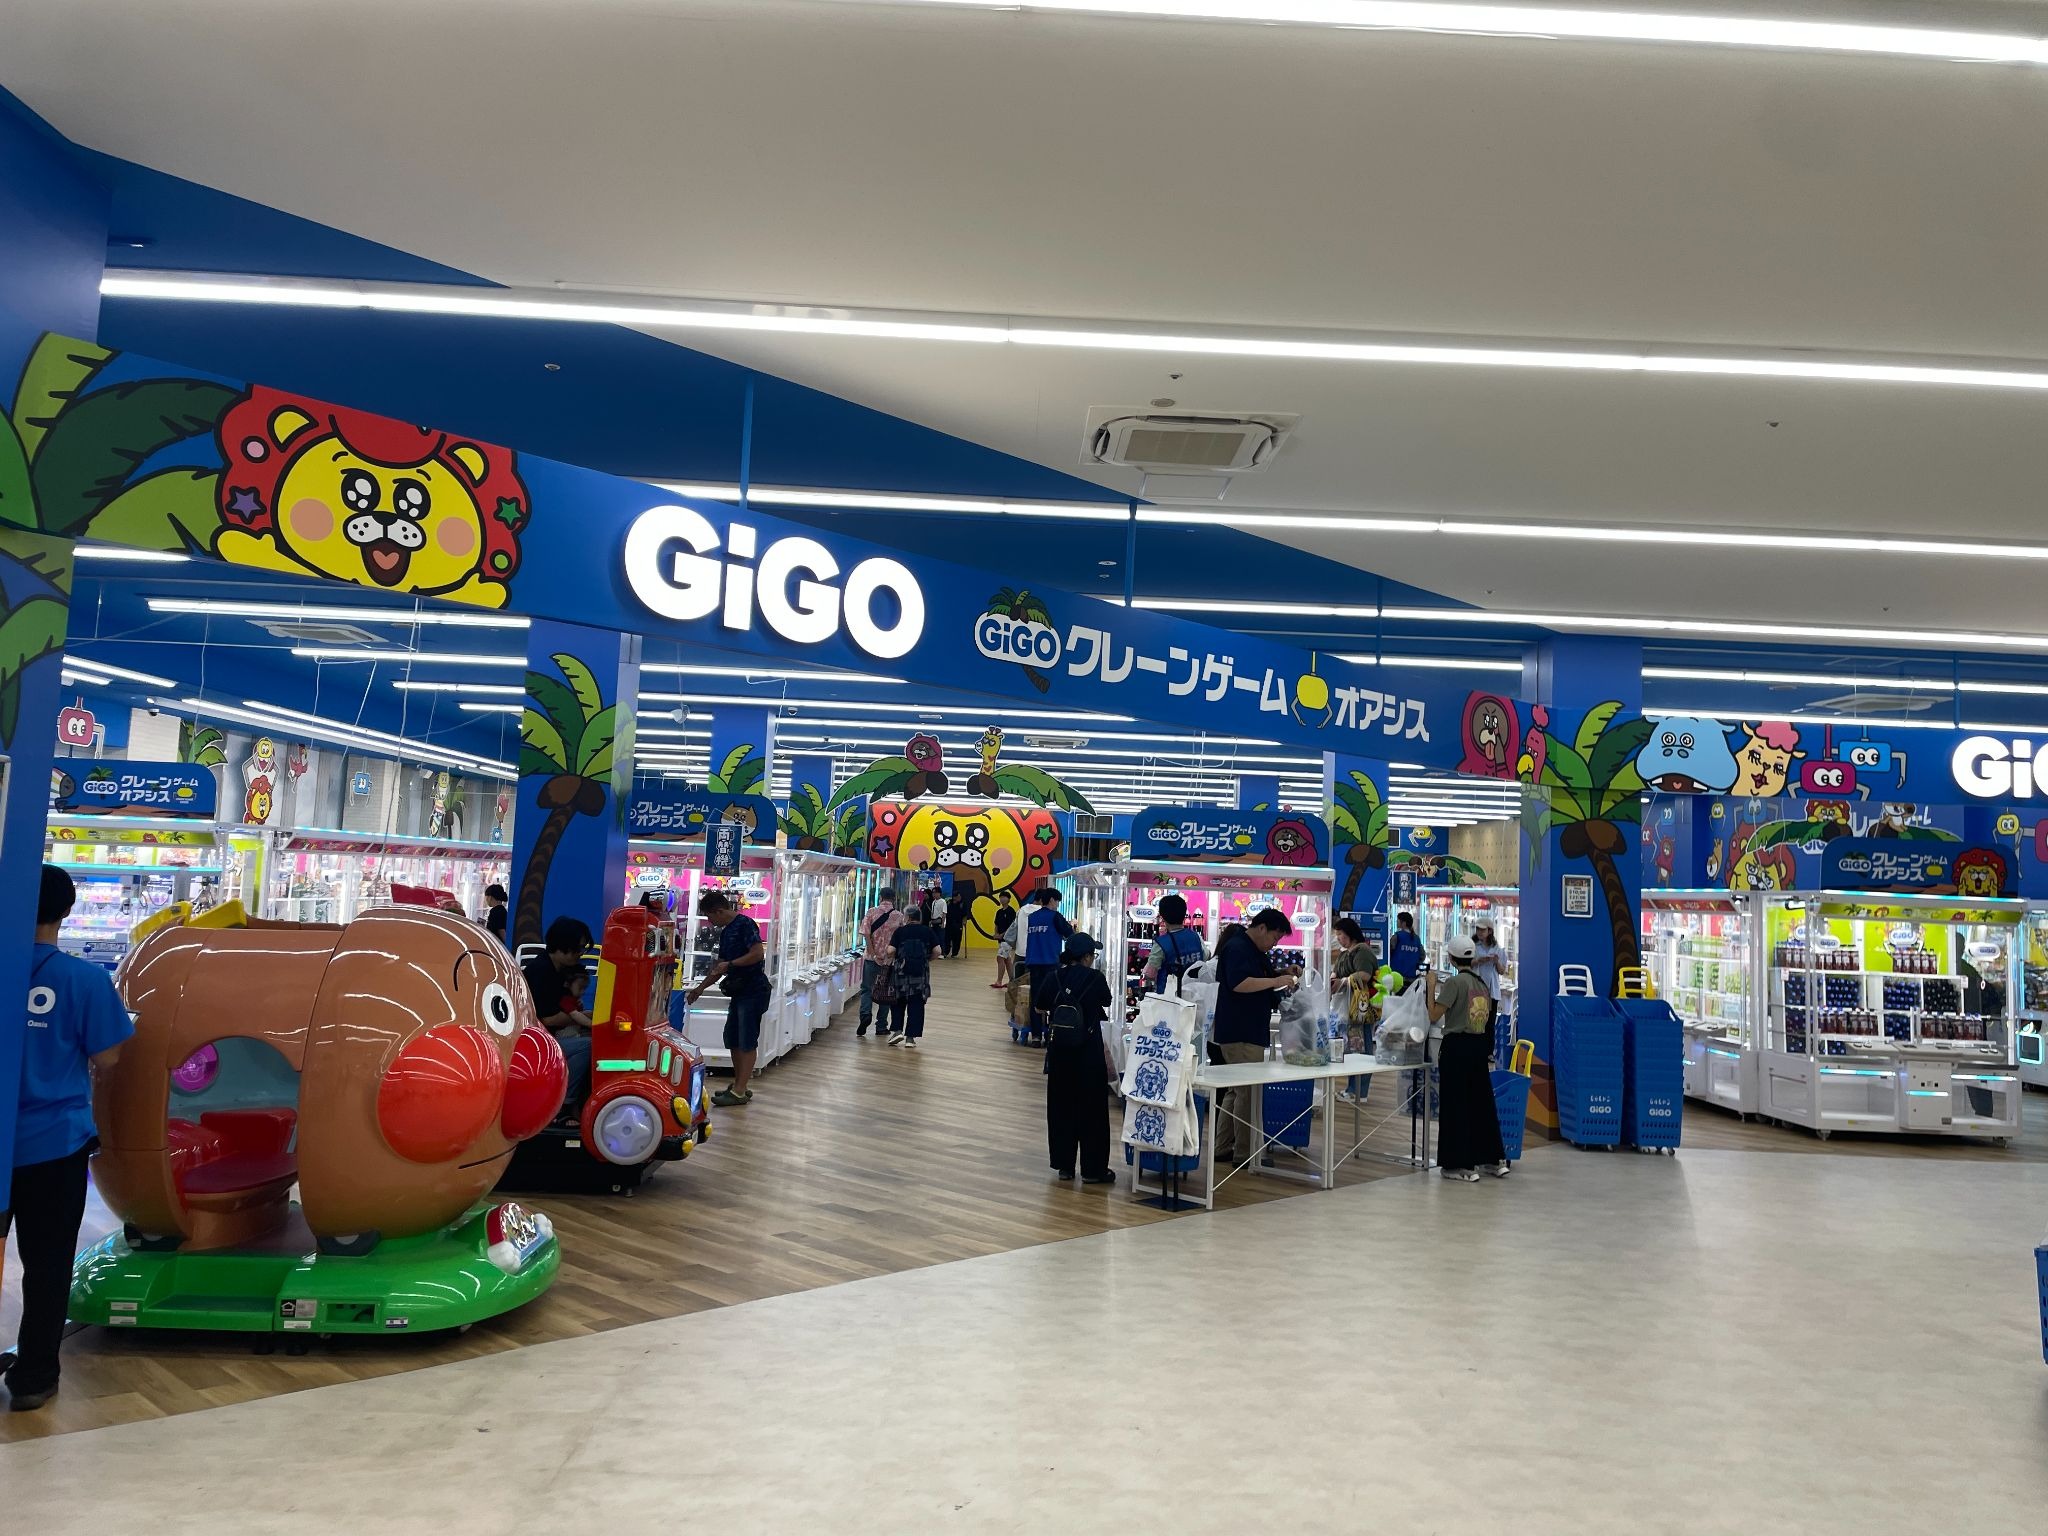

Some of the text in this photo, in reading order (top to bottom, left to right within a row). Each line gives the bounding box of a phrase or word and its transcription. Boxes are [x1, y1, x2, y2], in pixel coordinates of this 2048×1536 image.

[625, 505, 925, 659] GiGO
[978, 617, 1430, 743] GiGO クレーンゲーム オアシス
[1952, 735, 2048, 798] Gi
[85, 775, 199, 793] GiGO クレーンゲーム
[119, 789, 171, 803] オアシス
[636, 801, 710, 816] クレーンゲーム
[636, 814, 687, 829] オアシス
[1149, 821, 1257, 840] GiGO クレーンゲーム
[1179, 836, 1234, 851] オアシス
[1841, 852, 1948, 871] GiGO クレーンゲーム
[1871, 866, 1925, 882] オアシス
[731, 879, 752, 887] GiGO
[1401, 944, 1419, 953] STAFF
[1152, 1027, 1171, 1038] GiGO
[1135, 1046, 1164, 1060] オアシス
[1589, 1105, 1612, 1114] GiGO
[1648, 1108, 1672, 1117] GiGO
